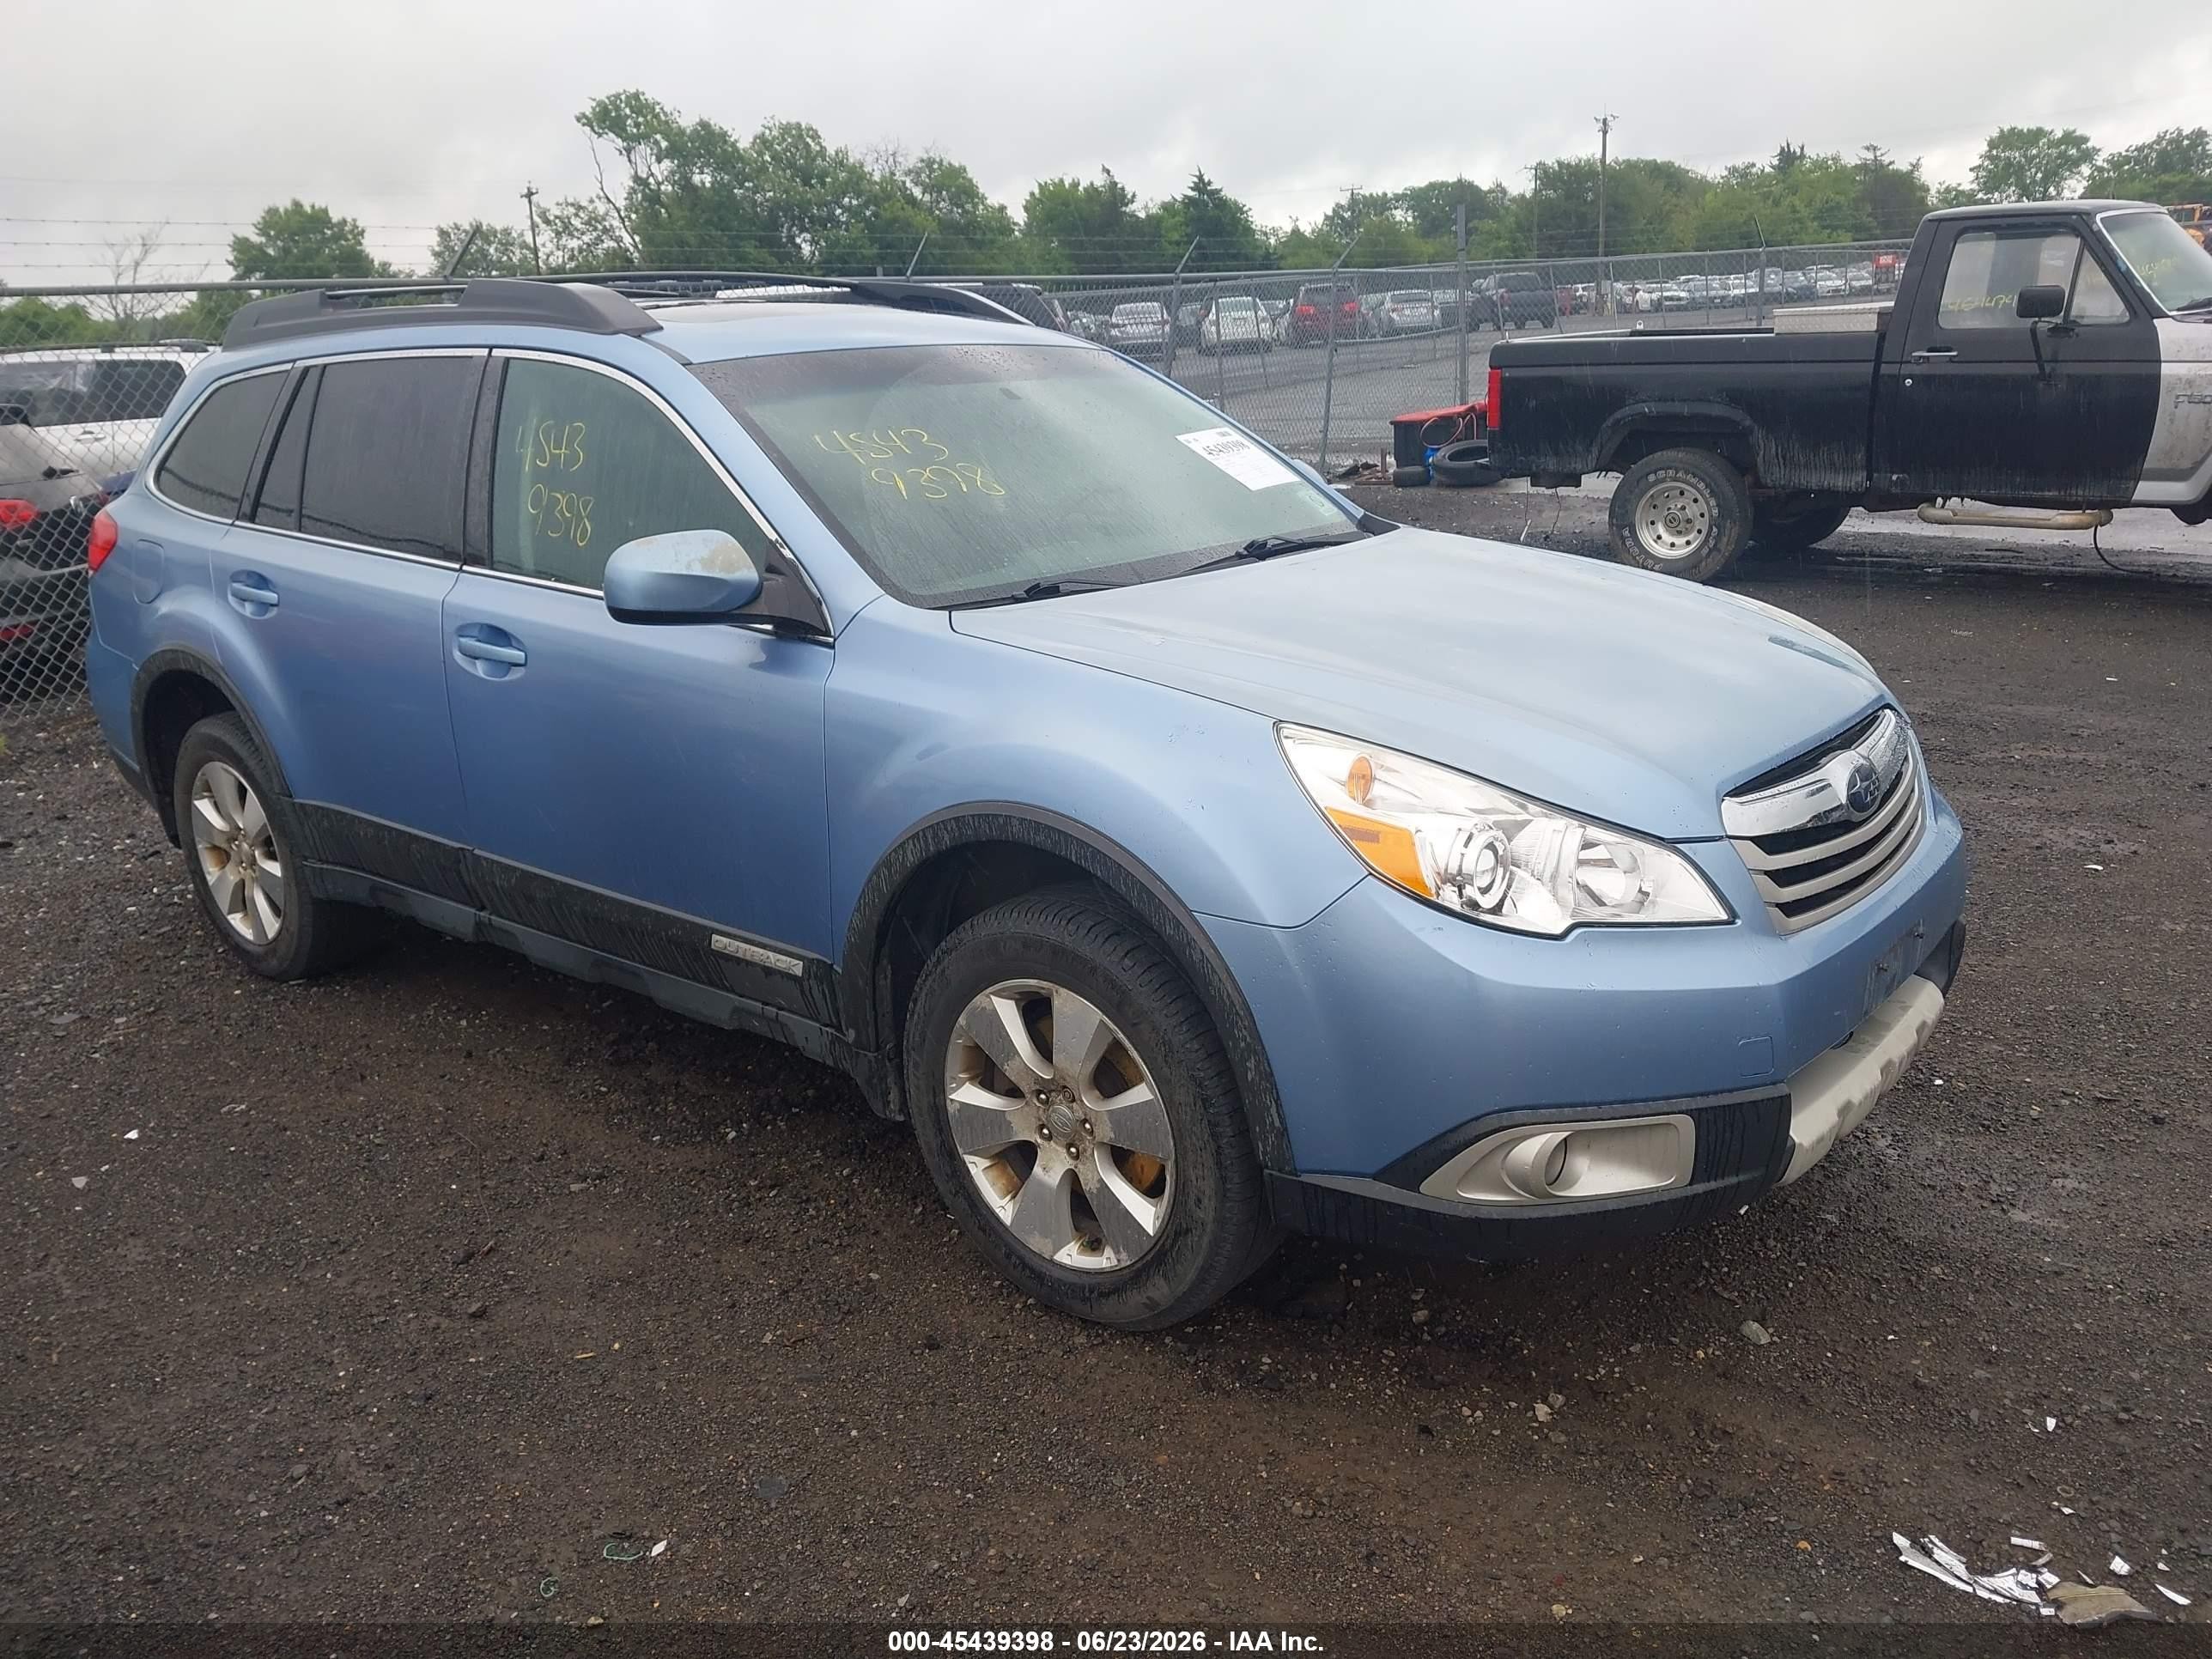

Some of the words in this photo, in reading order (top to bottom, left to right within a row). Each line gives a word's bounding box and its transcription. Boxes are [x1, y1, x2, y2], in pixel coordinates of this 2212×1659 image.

[515, 418, 586, 472] 4543
[815, 428, 949, 465] 4543
[528, 483, 595, 546] 9398
[713, 938, 801, 975] OUTBACK
